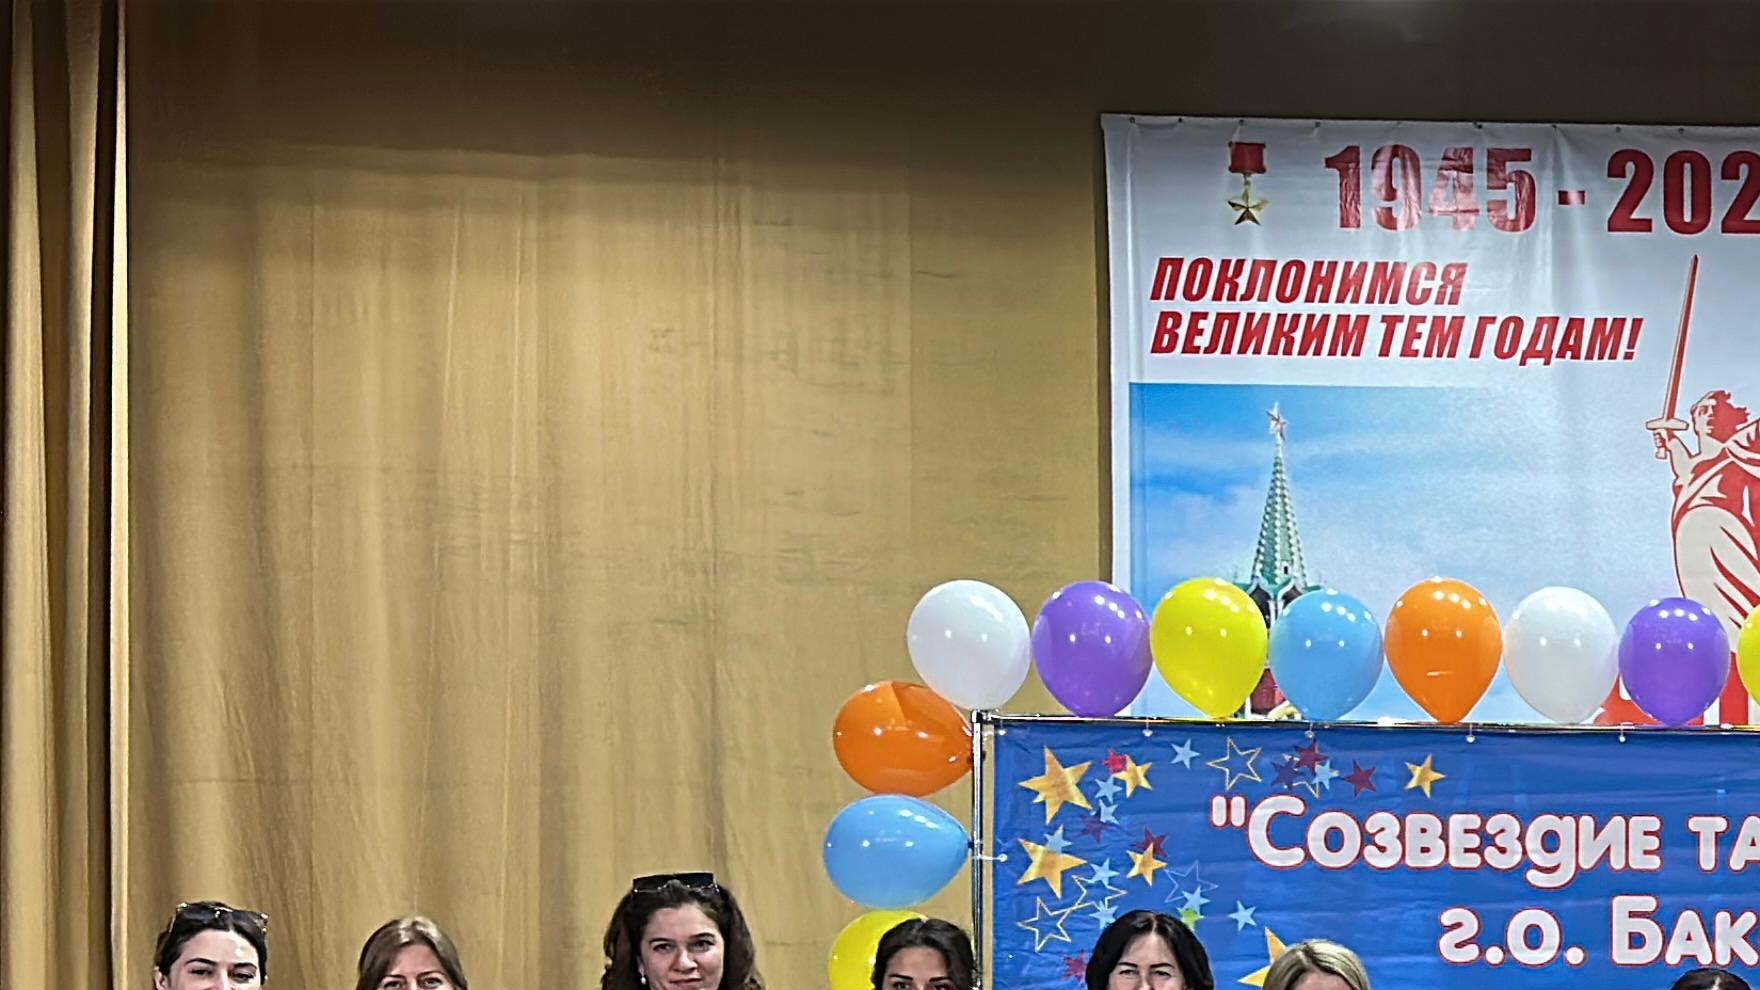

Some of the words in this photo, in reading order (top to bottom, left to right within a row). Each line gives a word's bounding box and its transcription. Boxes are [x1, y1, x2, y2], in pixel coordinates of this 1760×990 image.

[1326, 144, 1536, 232] 1945
[1150, 257, 1467, 306] ПОКЛОНИМСЯ
[1151, 311, 1370, 357] ВЕЛИКИМ
[1378, 315, 1466, 359] ТЕМ
[1469, 316, 1643, 366] ГОДАМ!
